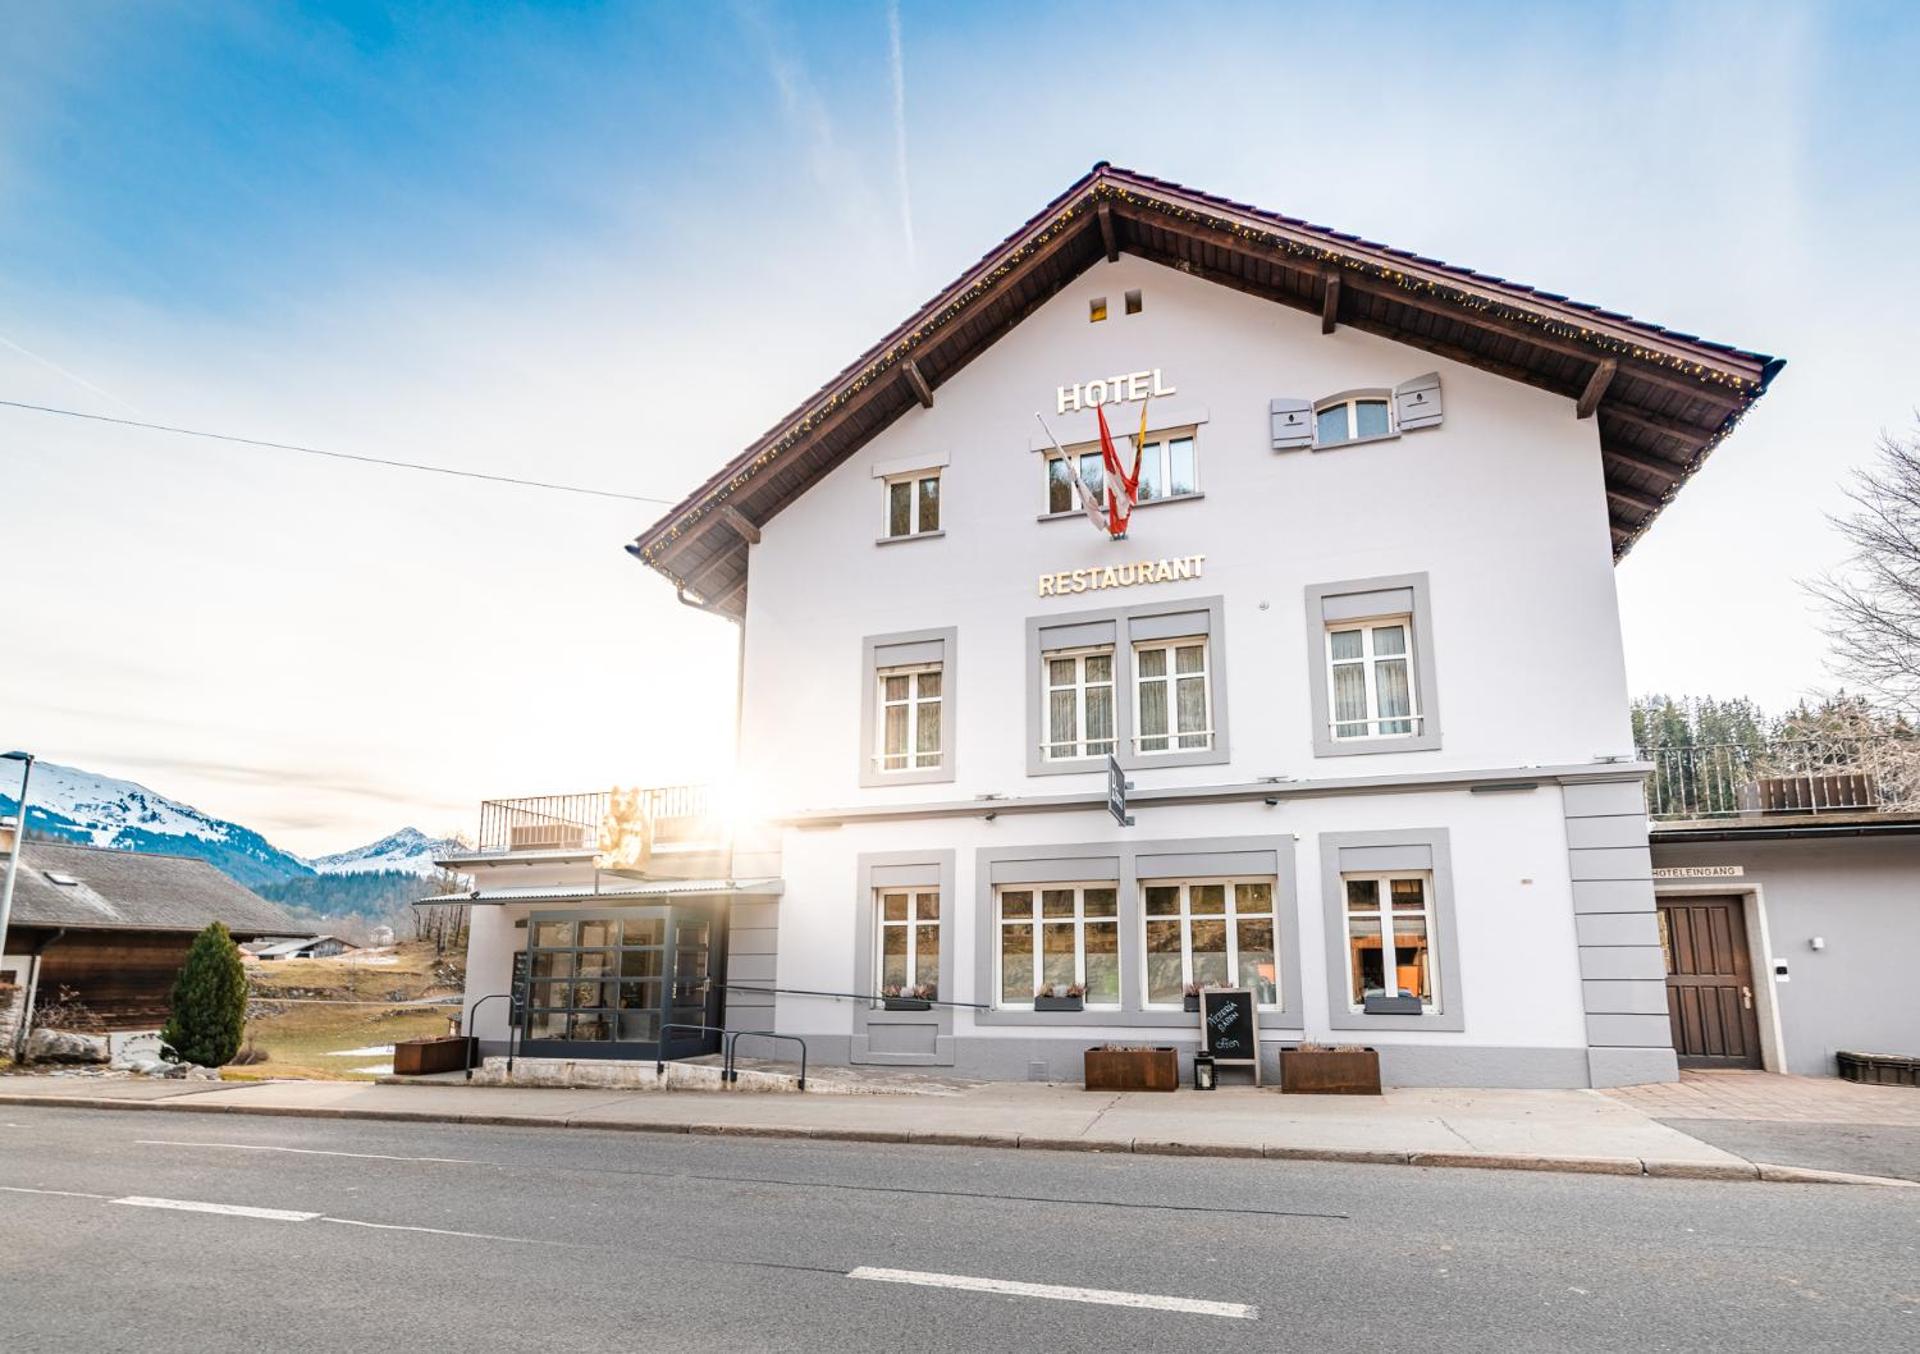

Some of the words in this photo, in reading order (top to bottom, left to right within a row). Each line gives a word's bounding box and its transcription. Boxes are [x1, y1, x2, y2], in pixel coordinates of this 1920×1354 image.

[1056, 368, 1177, 413] HOTEL
[1038, 554, 1206, 597] RESTAURANT
[1652, 866, 1735, 878] HOTELEINGANG
